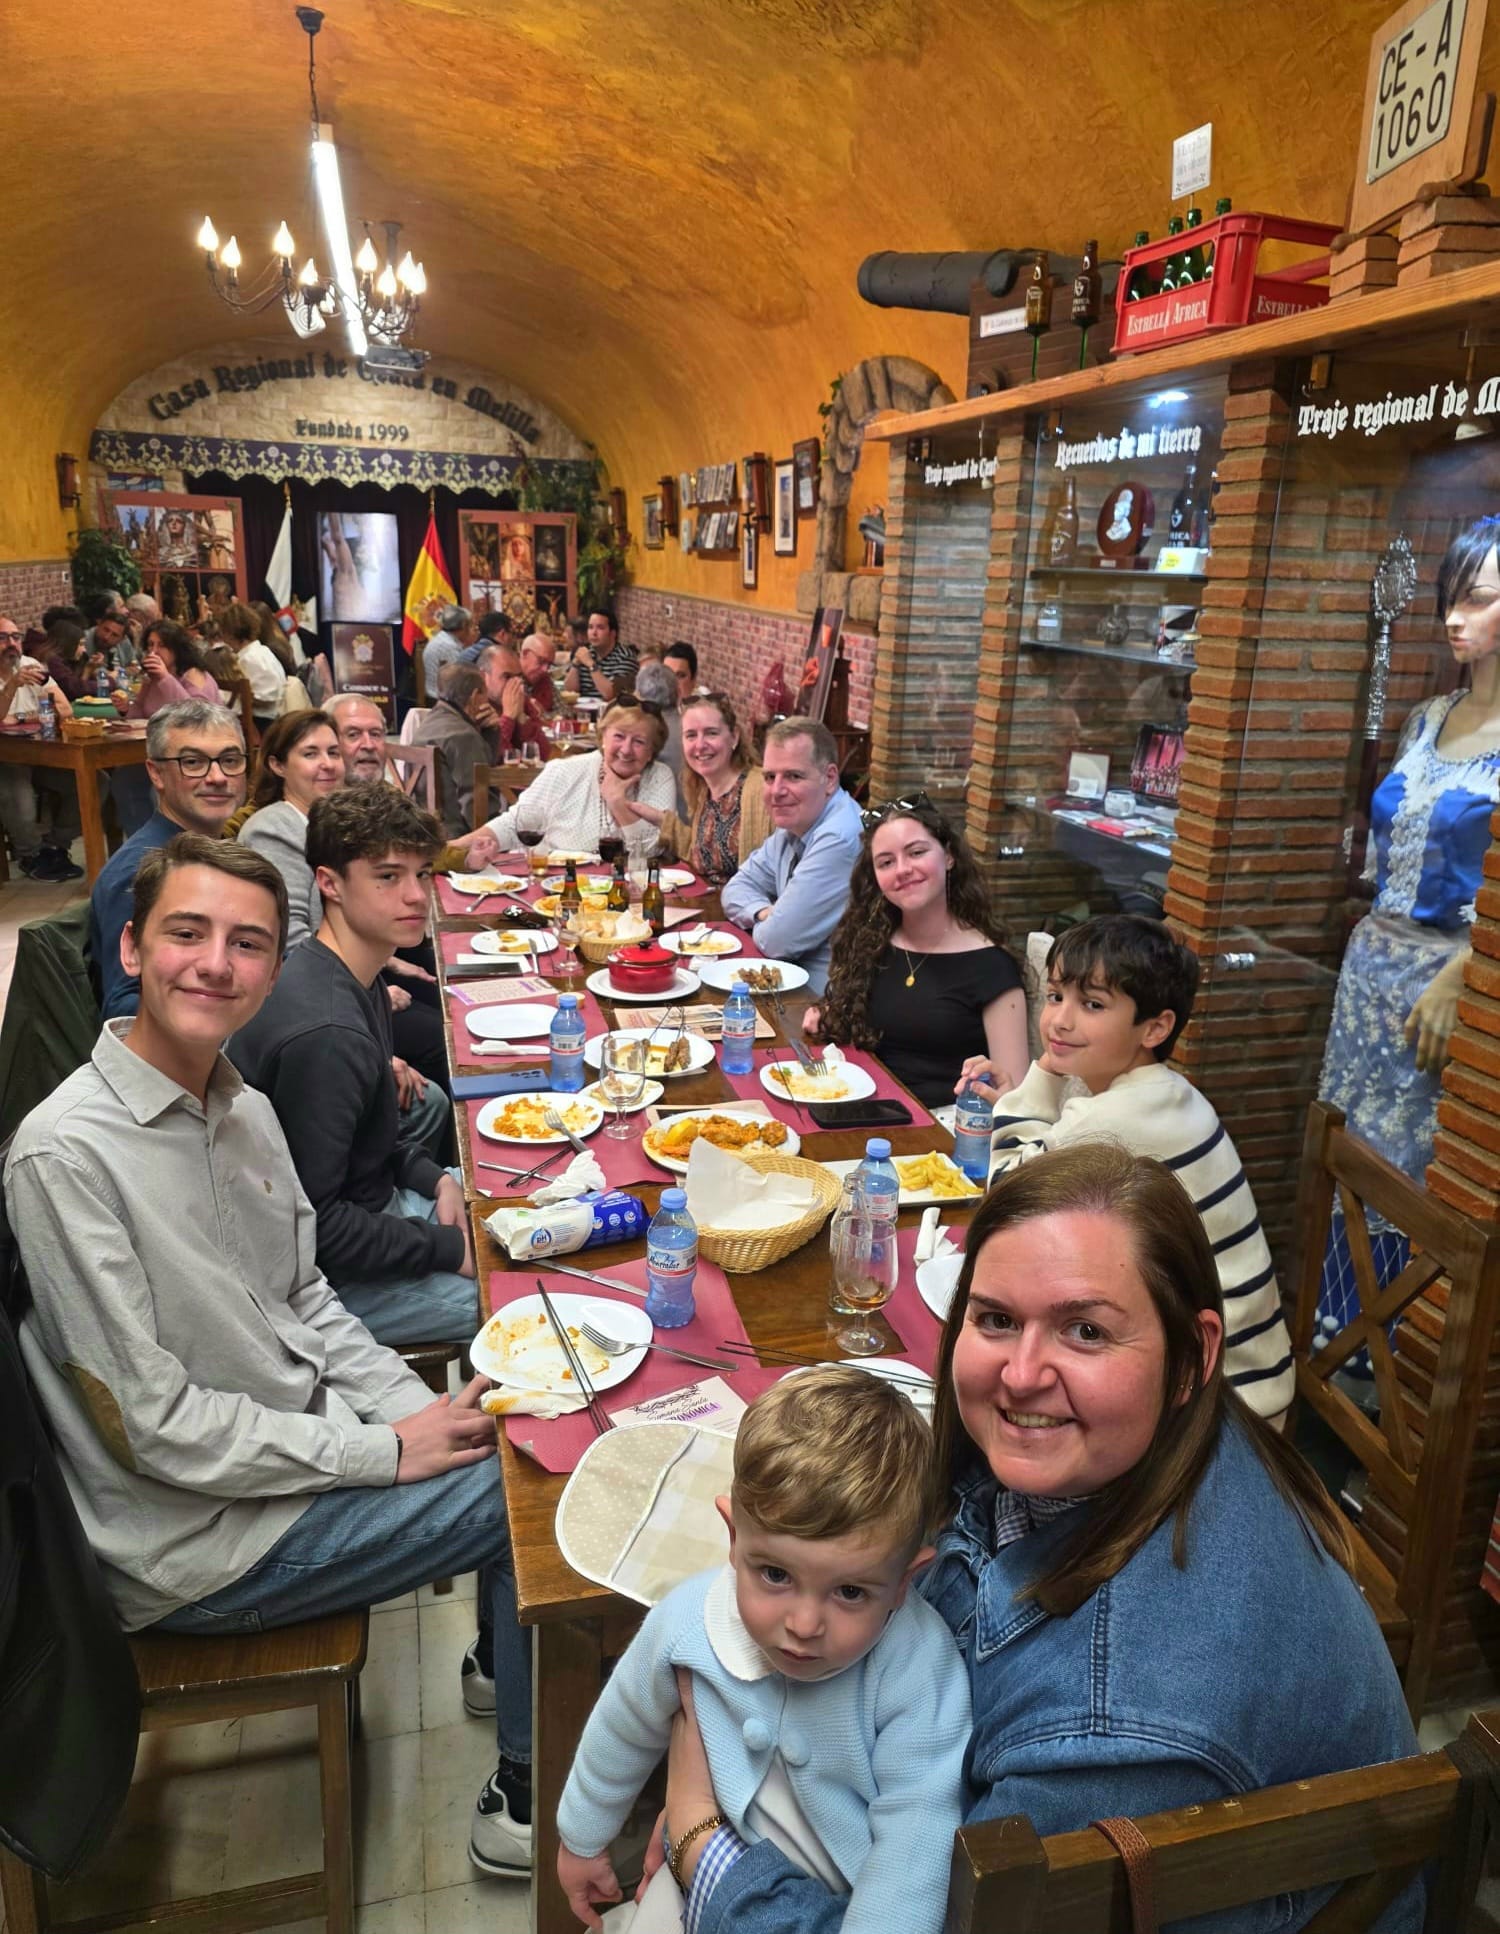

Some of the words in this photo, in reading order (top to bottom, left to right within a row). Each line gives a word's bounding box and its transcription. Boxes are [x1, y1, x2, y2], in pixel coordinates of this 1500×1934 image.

[1375, 71, 1447, 169] 1060
[1127, 309, 1170, 337] ESTRELLA
[1172, 299, 1208, 326] AFRICA
[1257, 295, 1312, 316] ESTRELL
[148, 378, 211, 420] Casa
[212, 352, 316, 393] Regional
[323, 351, 348, 379] de
[431, 376, 458, 400] en
[464, 386, 541, 445] Melilla
[1297, 399, 1349, 440] Traje
[1353, 383, 1439, 437] regional
[1441, 380, 1469, 419] de
[296, 418, 362, 440] Fundada
[368, 421, 410, 442] 1999
[1054, 431, 1119, 472] Recuerdos
[1118, 426, 1137, 460] de
[1137, 424, 1158, 458] mi
[1158, 423, 1202, 455] tierra
